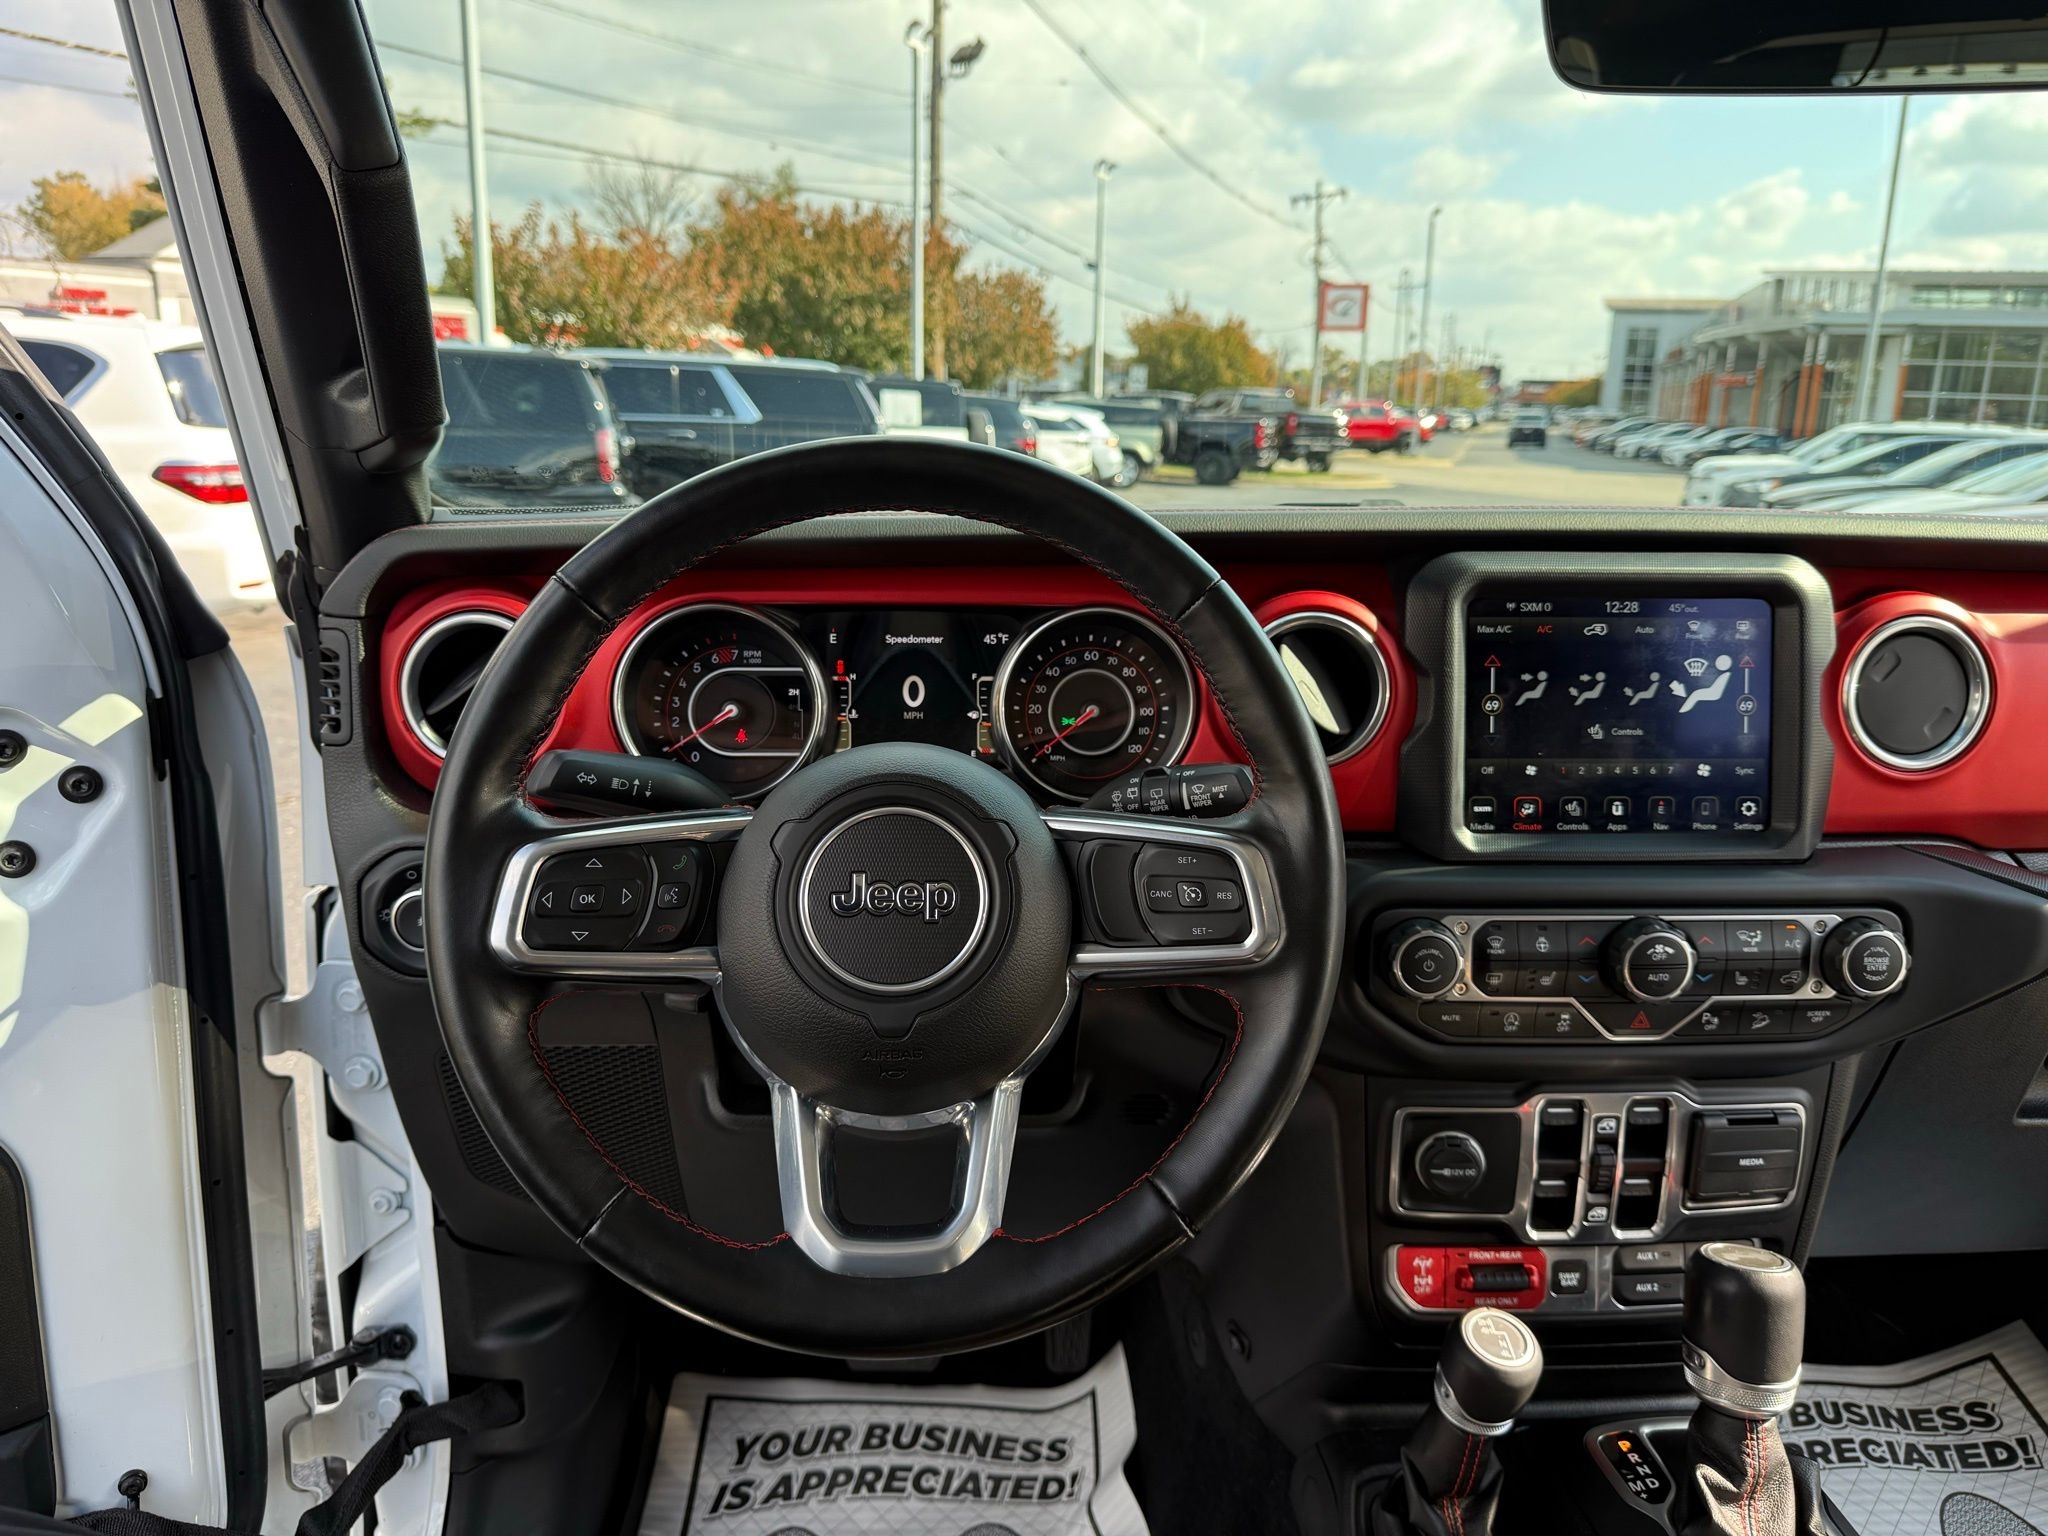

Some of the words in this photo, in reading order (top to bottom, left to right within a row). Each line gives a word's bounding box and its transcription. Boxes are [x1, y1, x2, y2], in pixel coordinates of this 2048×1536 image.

[1520, 602, 1542, 612] SXM
[1605, 602, 1640, 613] 12:28
[1477, 625, 1494, 633] Max
[1496, 625, 1512, 633] A/C
[1537, 625, 1552, 633] A/C
[1635, 626, 1654, 634] Auto
[829, 634, 837, 643] E
[885, 634, 944, 645] Speedometer
[711, 653, 719, 663] 6
[731, 650, 739, 661] 7
[1084, 652, 1099, 661] 60
[1065, 657, 1077, 665] 50
[1107, 657, 1118, 665] 70
[693, 662, 701, 673] 5
[1046, 667, 1060, 677] 40
[1123, 667, 1136, 677] 80
[679, 678, 687, 689] 4
[902, 675, 926, 708] 0
[1035, 685, 1047, 694] 30
[1136, 685, 1147, 694] 90
[672, 697, 680, 708] 3
[1485, 701, 1499, 710] 69
[1739, 701, 1753, 711] 69
[1028, 705, 1042, 714] 20
[1139, 707, 1153, 716] 100
[903, 711, 924, 720] MPH
[672, 717, 680, 727] 2
[1034, 727, 1043, 735] 10
[1138, 727, 1150, 735] 110
[1612, 728, 1643, 736] Controls
[1128, 745, 1142, 753] 120
[691, 751, 700, 763] 0
[1481, 766, 1494, 774] Off
[1735, 767, 1755, 776] Sync
[1212, 785, 1228, 793] MIST
[1191, 793, 1211, 801] FRONT
[1192, 800, 1213, 808] WIPER
[1607, 823, 1627, 831] Apps
[1733, 823, 1764, 831] Settings
[579, 895, 595, 903] OK
[831, 871, 957, 922] Jeep
[1785, 940, 1801, 948] A/C
[1652, 953, 1667, 961] OFF
[863, 1050, 923, 1061] AIRBAG
[1739, 1158, 1764, 1166] MEDIA
[1637, 1252, 1653, 1260] AUX
[1414, 1286, 1431, 1294] OFF
[1636, 1284, 1652, 1292] AUX
[1475, 1297, 1497, 1305] REAR
[1497, 1297, 1519, 1305] ONLY
[1789, 1400, 1998, 1433] BUSINESS
[733, 1423, 850, 1467] YOUR
[860, 1423, 1069, 1463] BUSINESS
[1618, 1440, 1631, 1452] P
[1627, 1453, 1642, 1463] R
[1636, 1464, 1652, 1476] N
[1628, 1480, 1646, 1492] M
[1645, 1478, 1659, 1488] D
[708, 1480, 755, 1516] IS
[762, 1465, 1081, 1503] APPRECIATED!
